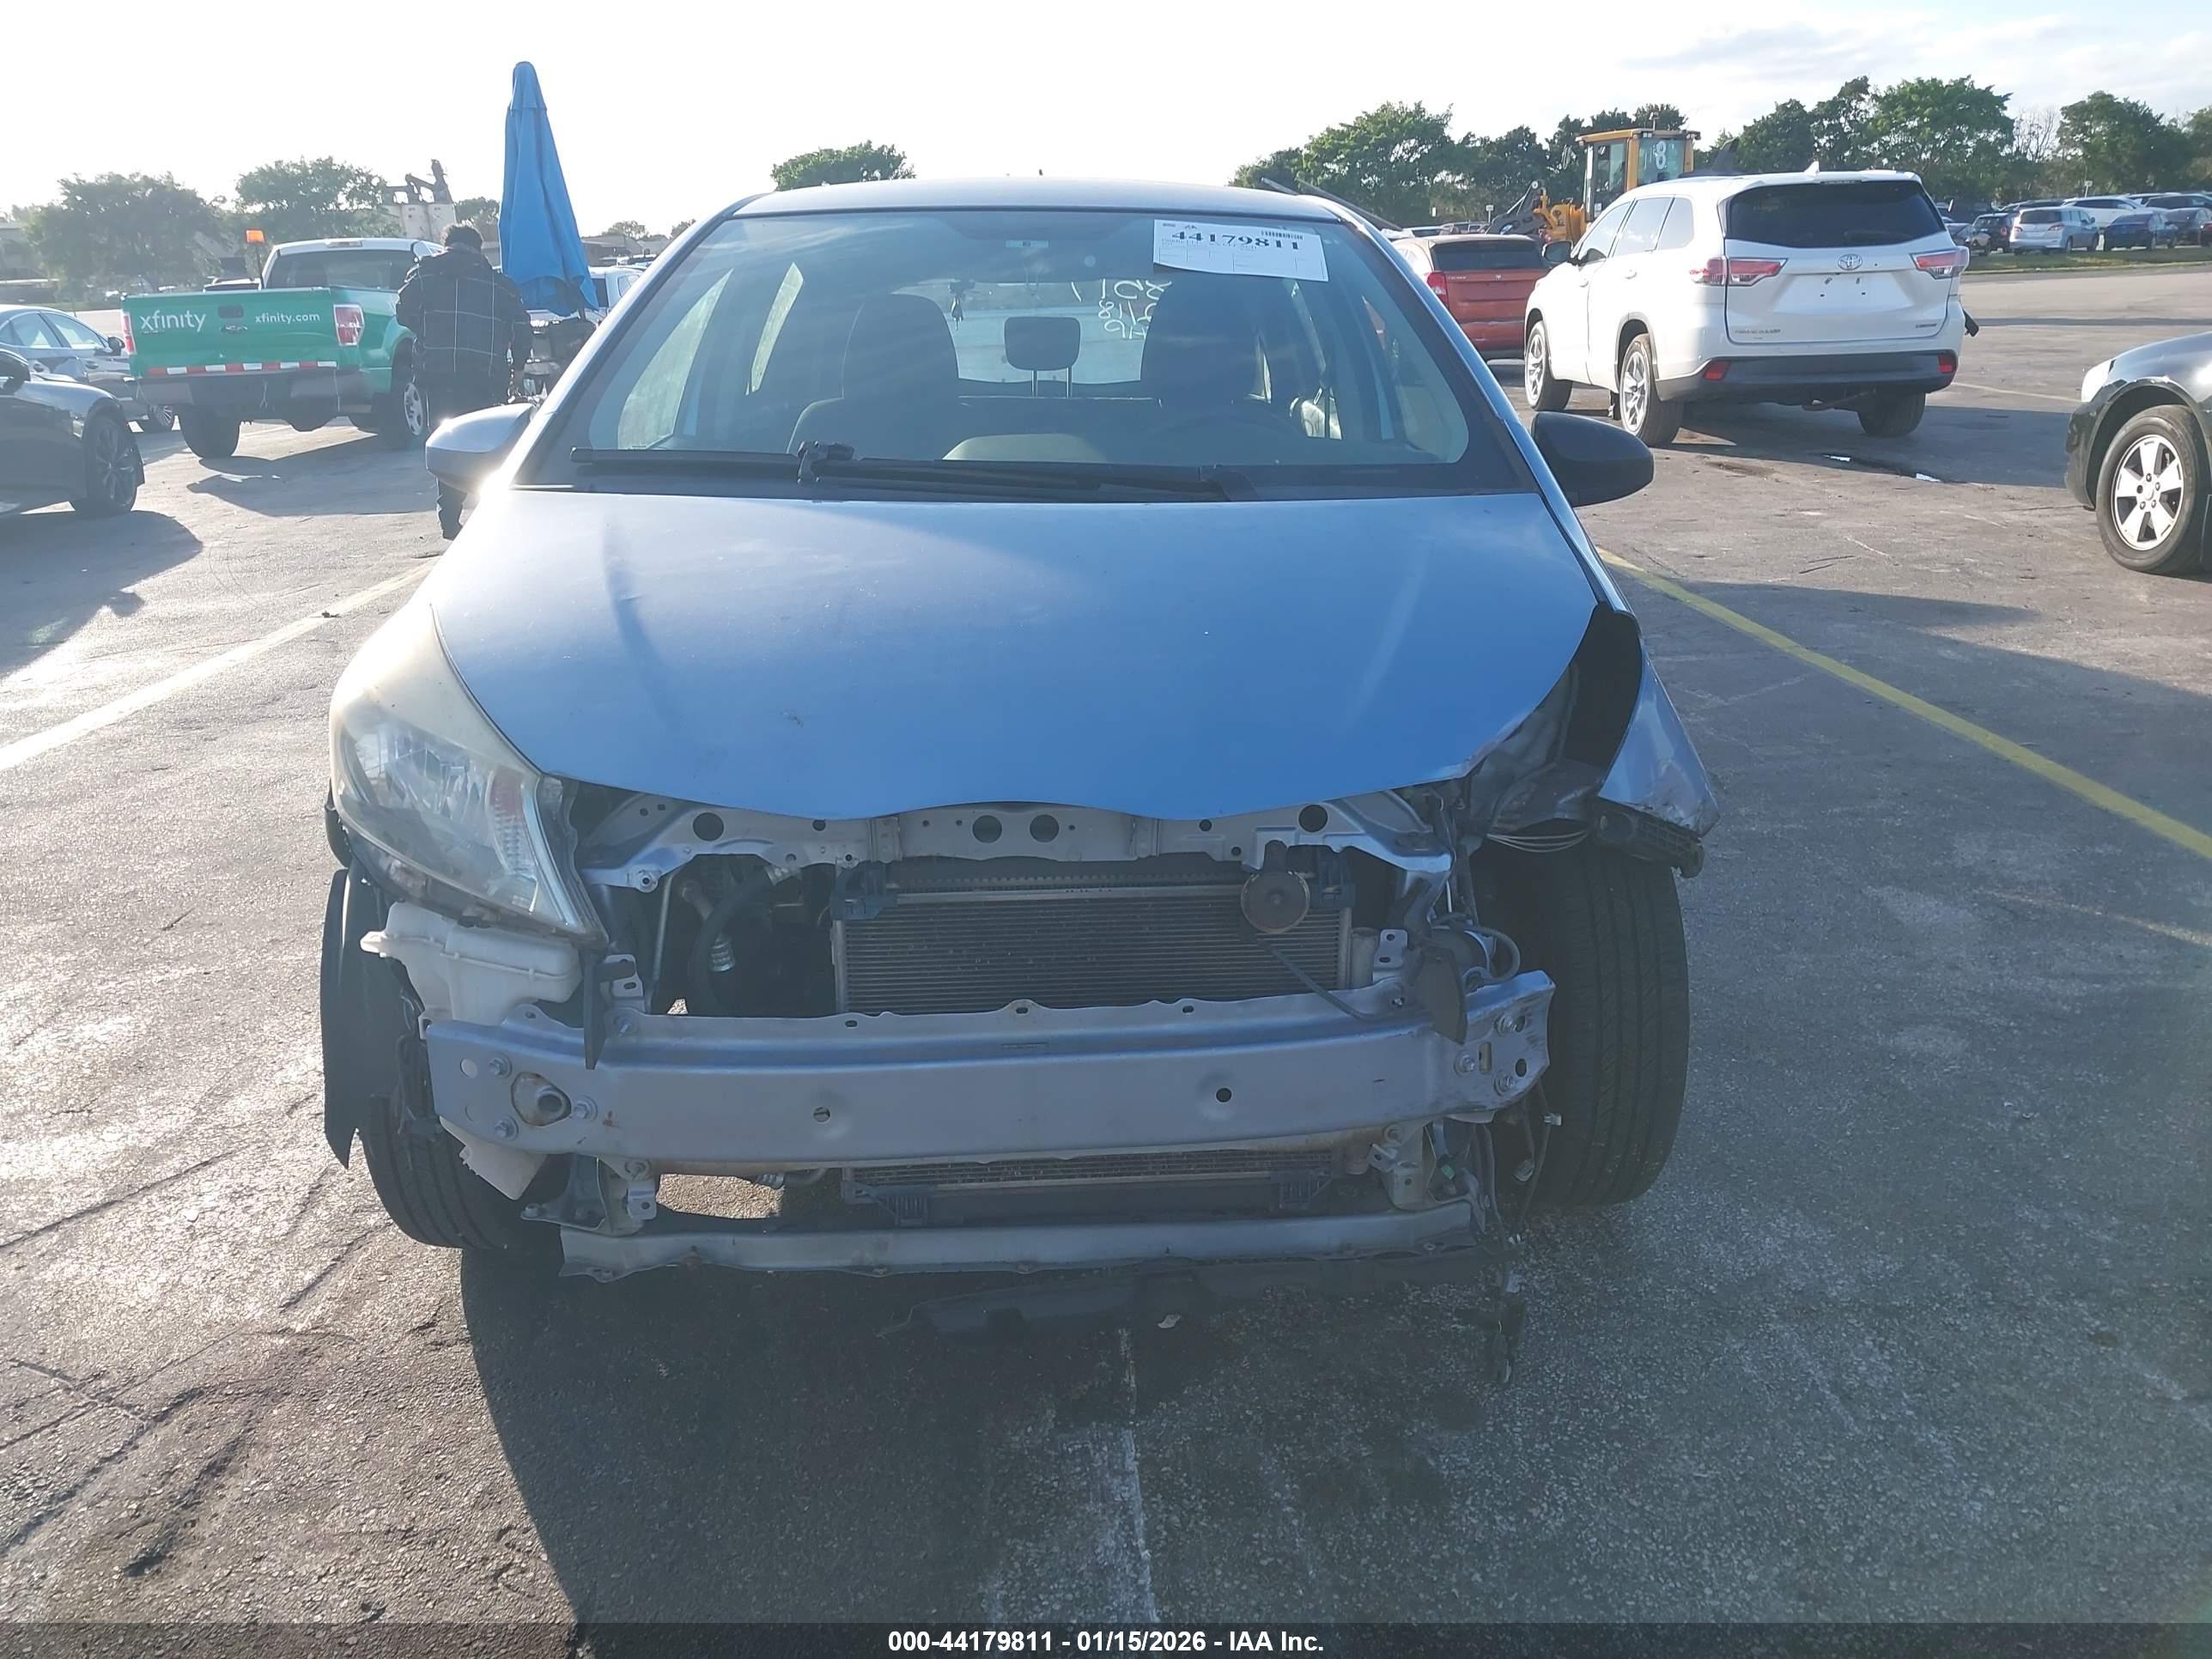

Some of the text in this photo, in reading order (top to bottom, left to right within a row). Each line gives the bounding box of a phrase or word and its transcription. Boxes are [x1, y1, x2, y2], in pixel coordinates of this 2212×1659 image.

[1171, 230, 1298, 251] 44179811
[139, 309, 207, 333] xfinity
[254, 312, 321, 325] xfinity.com
